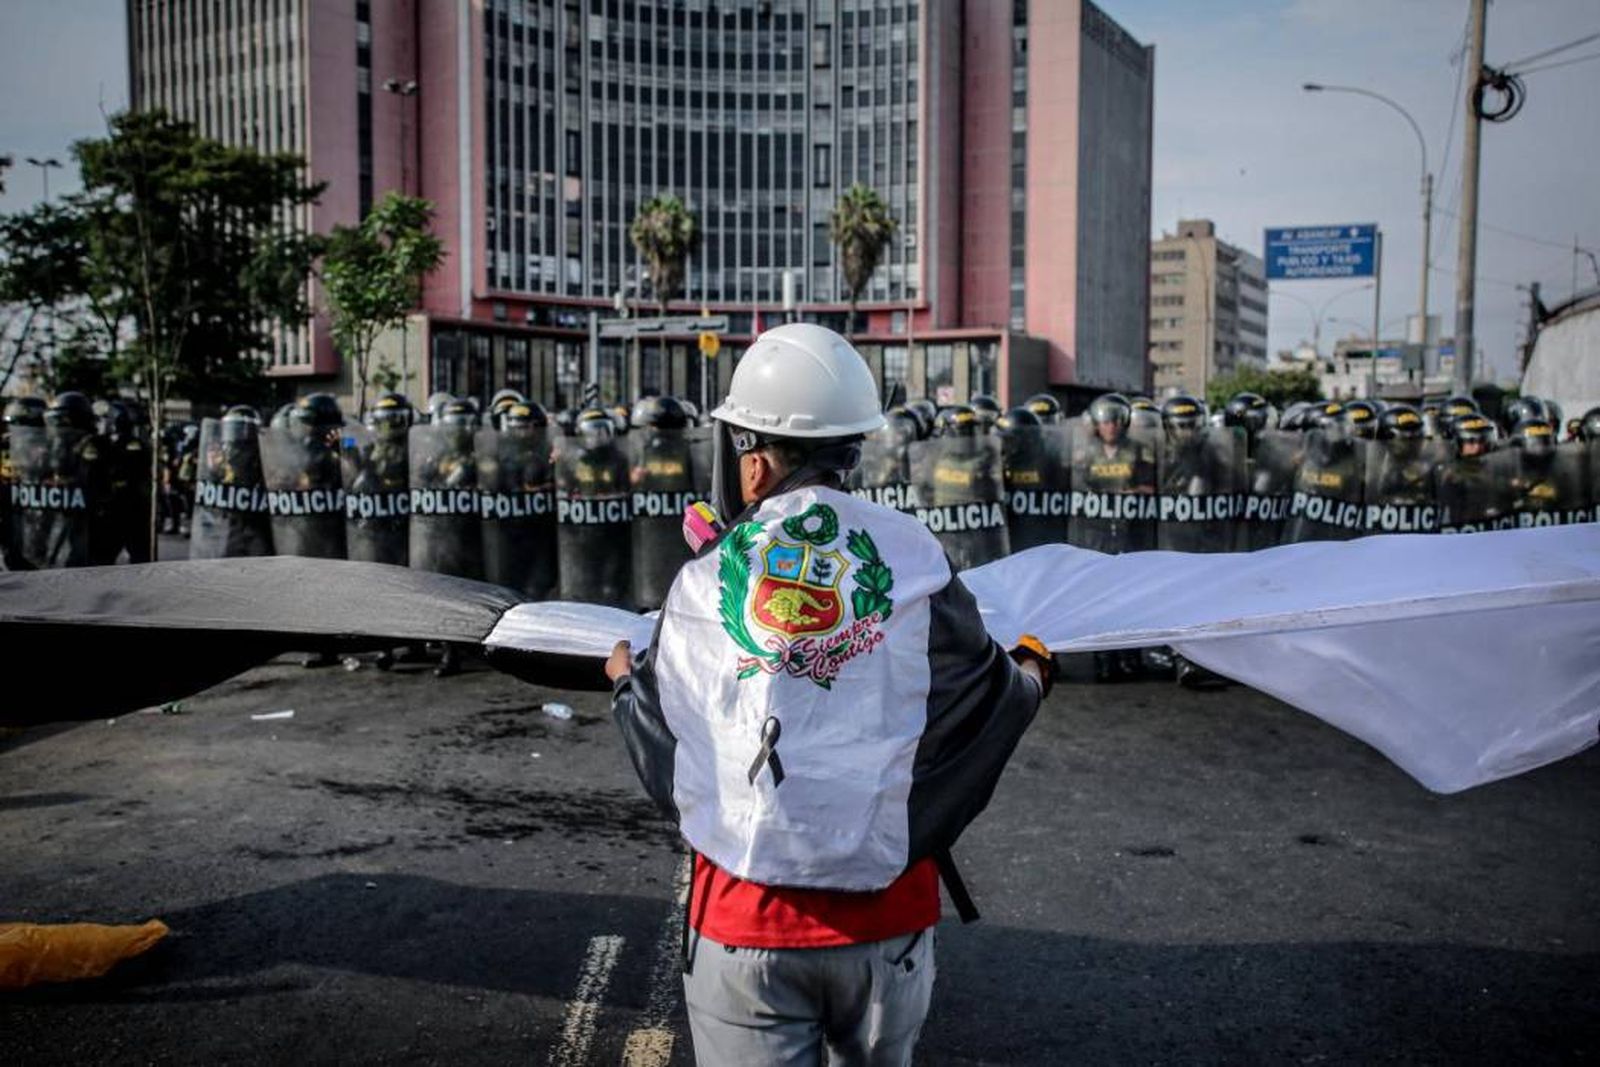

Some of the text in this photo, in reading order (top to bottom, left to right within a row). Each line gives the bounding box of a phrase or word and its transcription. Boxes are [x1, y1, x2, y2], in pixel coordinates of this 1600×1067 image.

[1288, 243, 1352, 255] TRANSPORTE
[11, 485, 86, 509] POLICIA
[345, 493, 409, 518] POLIC
[410, 489, 479, 514] POLICI
[481, 492, 552, 519] POLICI
[632, 491, 699, 515] POLIC
[1006, 491, 1069, 515] OLICI
[1070, 490, 1158, 519] POLICIA
[1291, 491, 1362, 528] POLICI
[557, 499, 629, 523] POLICI
[916, 503, 1005, 531] POLICIA
[802, 611, 882, 662] Siempre
[813, 631, 885, 680] Contigo
